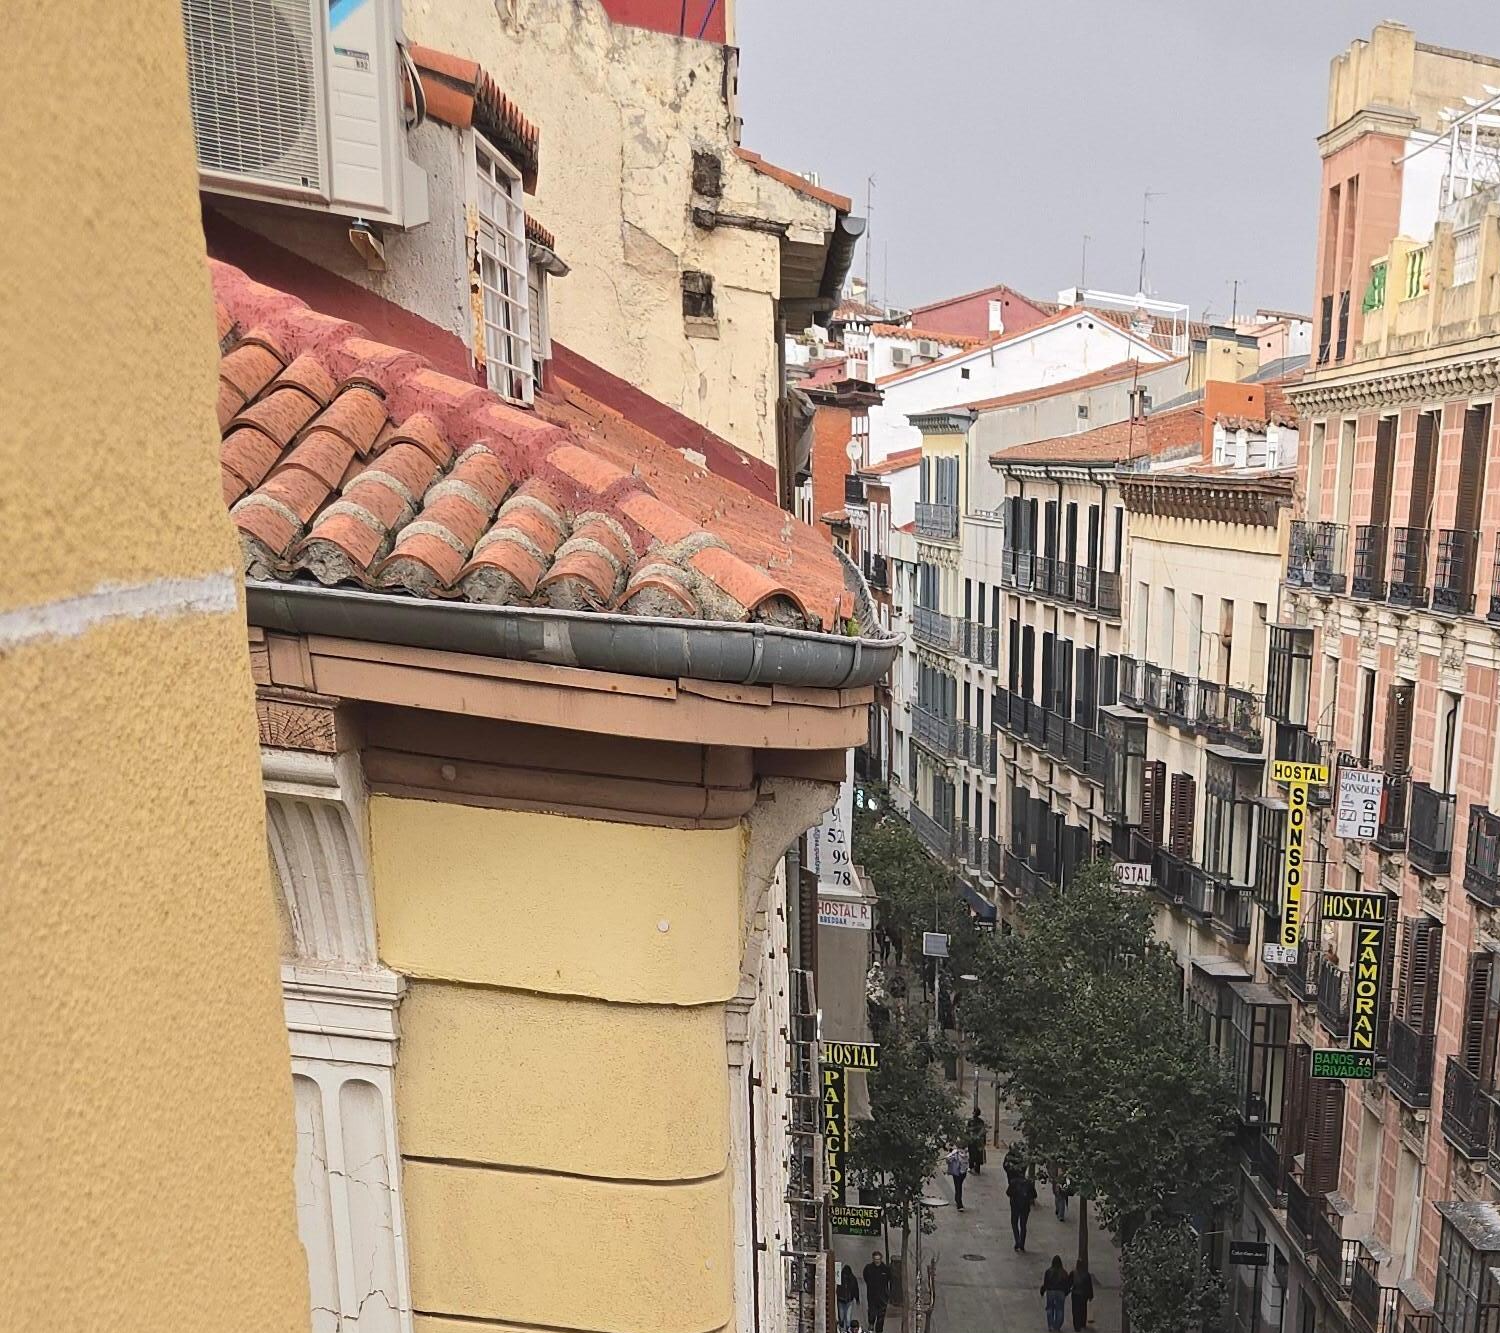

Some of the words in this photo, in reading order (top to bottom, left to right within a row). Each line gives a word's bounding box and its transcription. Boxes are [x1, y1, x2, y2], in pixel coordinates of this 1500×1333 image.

[1274, 763, 1326, 782] HOSTAL
[1342, 769, 1370, 783] HOSTAL
[1340, 781, 1382, 797] SONSOLES
[832, 849, 850, 866] 99
[1284, 787, 1305, 945] SONSOLES
[833, 870, 852, 887] 78
[817, 900, 858, 919] HOSTAL
[860, 905, 871, 920] R.
[1323, 894, 1385, 920] HOSTAL
[1353, 928, 1380, 1049] ZAMORAN
[825, 1043, 879, 1067] HOSTAL
[1314, 1052, 1355, 1065] BAÑOS
[1313, 1064, 1372, 1078] PRIVADOS
[830, 1206, 879, 1219] ABITACIONES
[832, 1216, 849, 1226] CON
